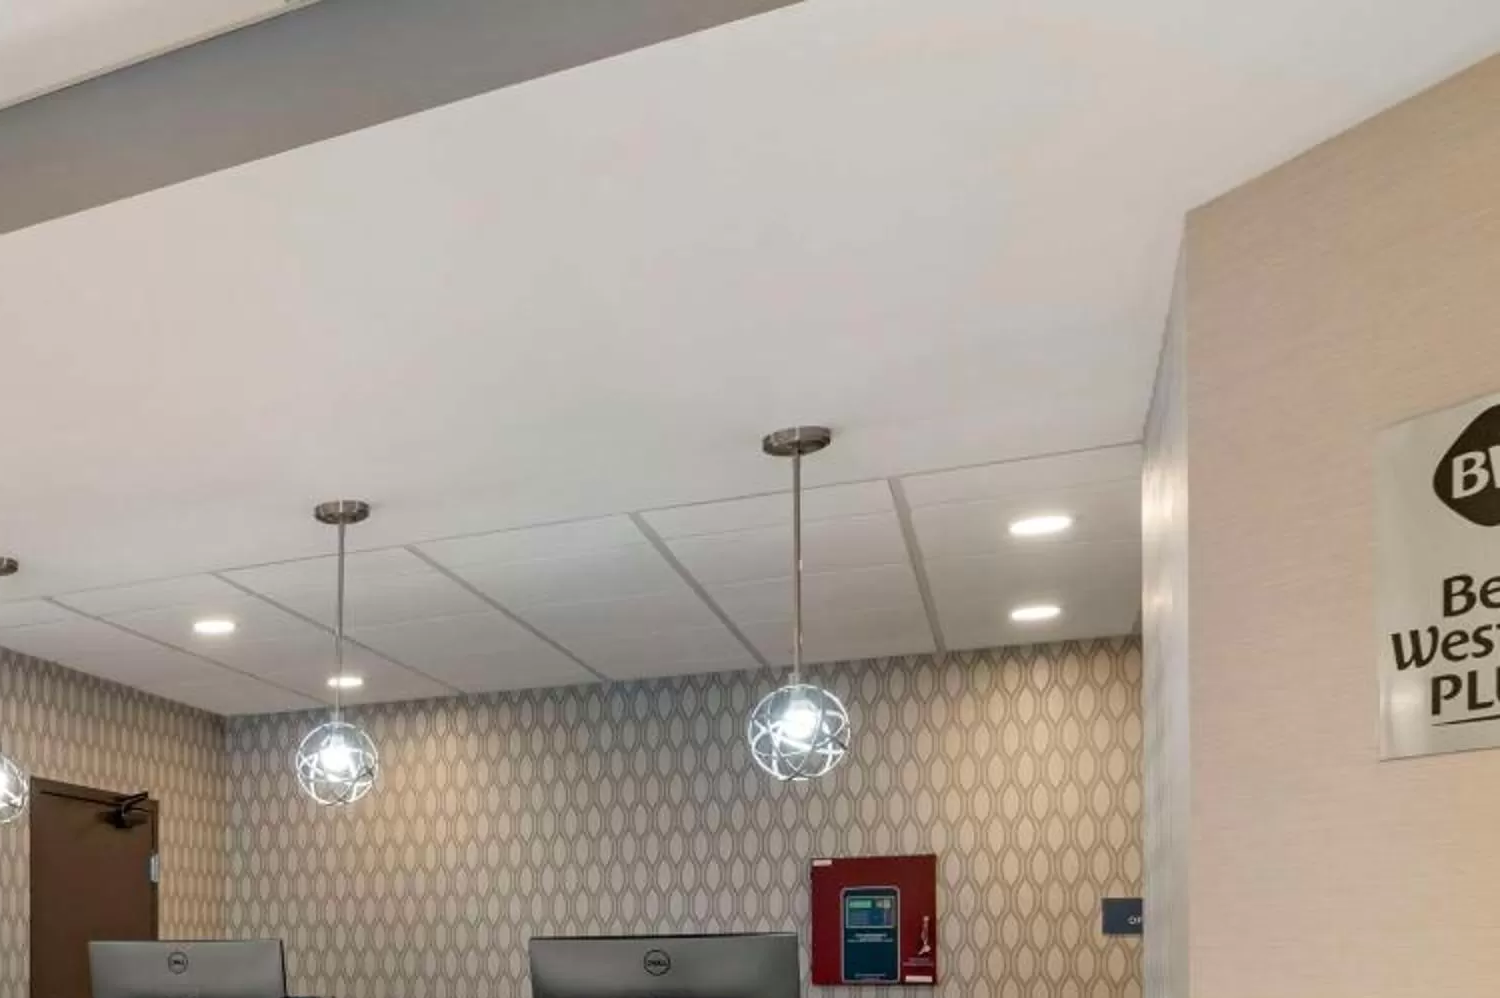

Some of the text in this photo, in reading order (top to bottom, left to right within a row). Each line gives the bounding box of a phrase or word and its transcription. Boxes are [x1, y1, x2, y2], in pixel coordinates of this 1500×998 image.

[1452, 445, 1500, 498] B
[1443, 574, 1500, 617] Be
[1391, 624, 1500, 671] Wes
[1431, 667, 1500, 715] PL
